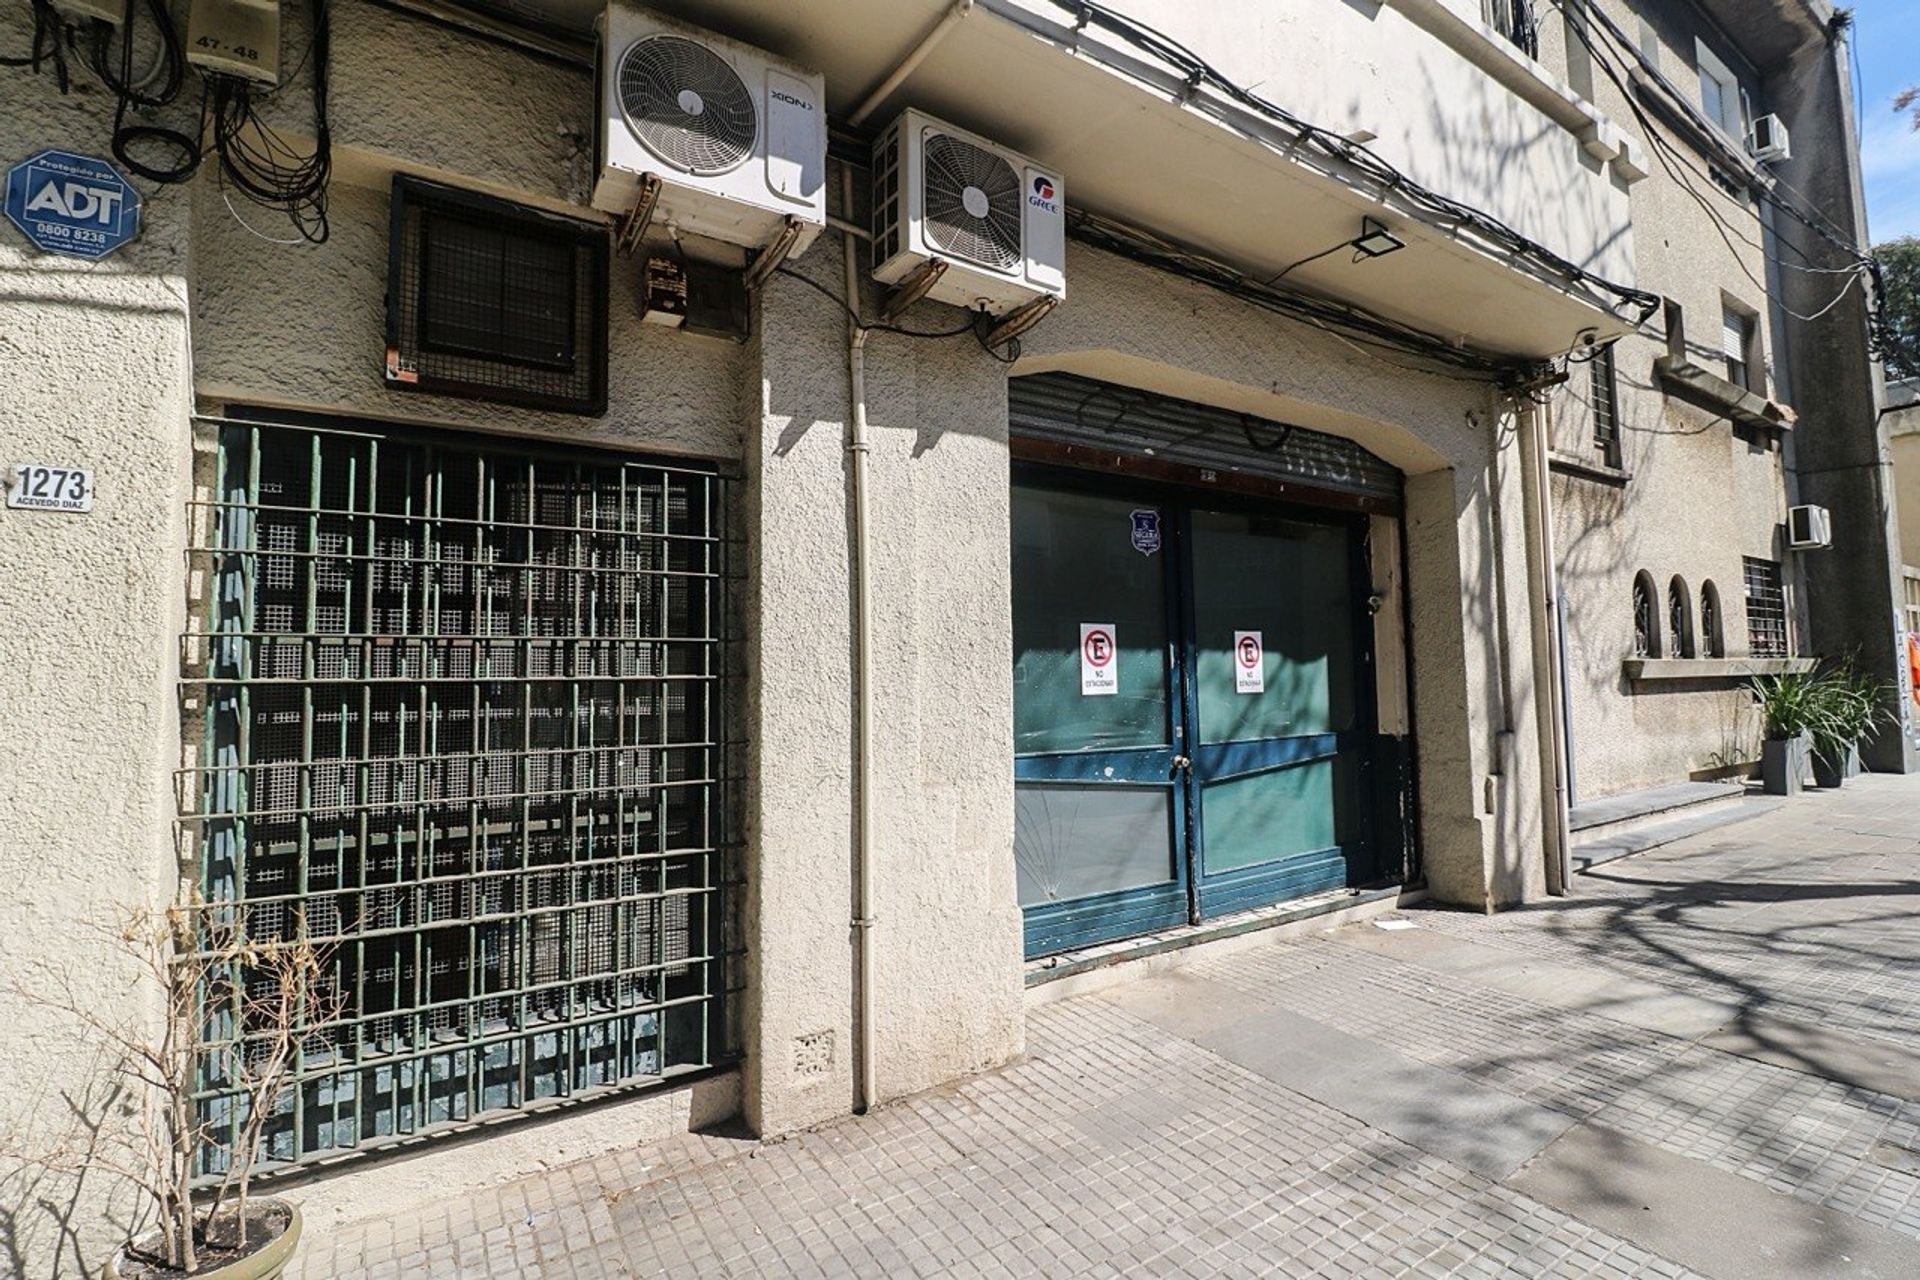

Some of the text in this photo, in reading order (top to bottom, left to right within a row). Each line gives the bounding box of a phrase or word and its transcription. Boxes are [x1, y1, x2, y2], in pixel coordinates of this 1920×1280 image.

[39, 160, 115, 180] Protegido por
[26, 180, 122, 224] ADT
[1029, 196, 1059, 214] GREE
[37, 223, 70, 237] 0800
[74, 228, 106, 243] 8238
[17, 467, 85, 500] 1273
[16, 497, 84, 509] ACEVEDO DIAZ
